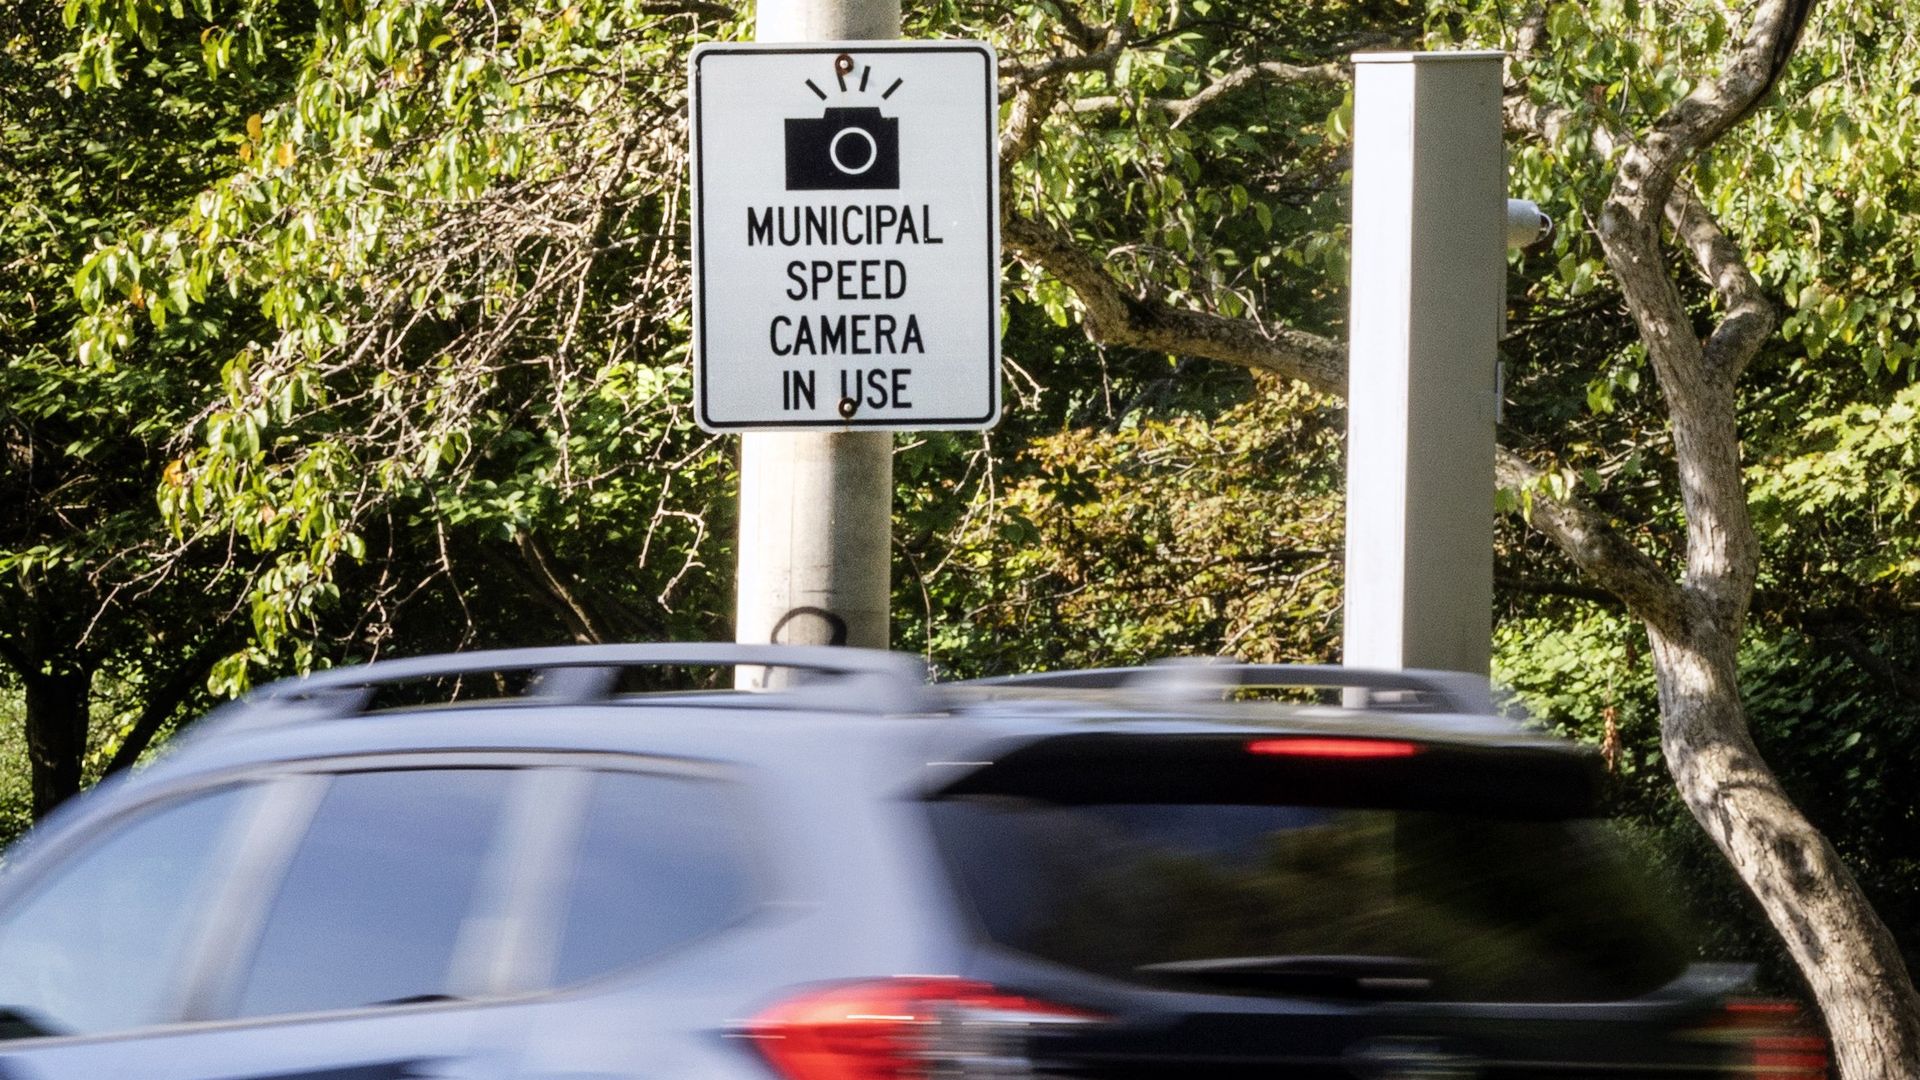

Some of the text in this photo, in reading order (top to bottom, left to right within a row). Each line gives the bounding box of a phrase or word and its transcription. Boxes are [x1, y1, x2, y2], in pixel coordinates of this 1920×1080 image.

[747, 204, 944, 247] MUNICIPAL
[786, 260, 907, 301] SPEED
[769, 314, 925, 356] CAMERA
[783, 369, 913, 411] IN USE
